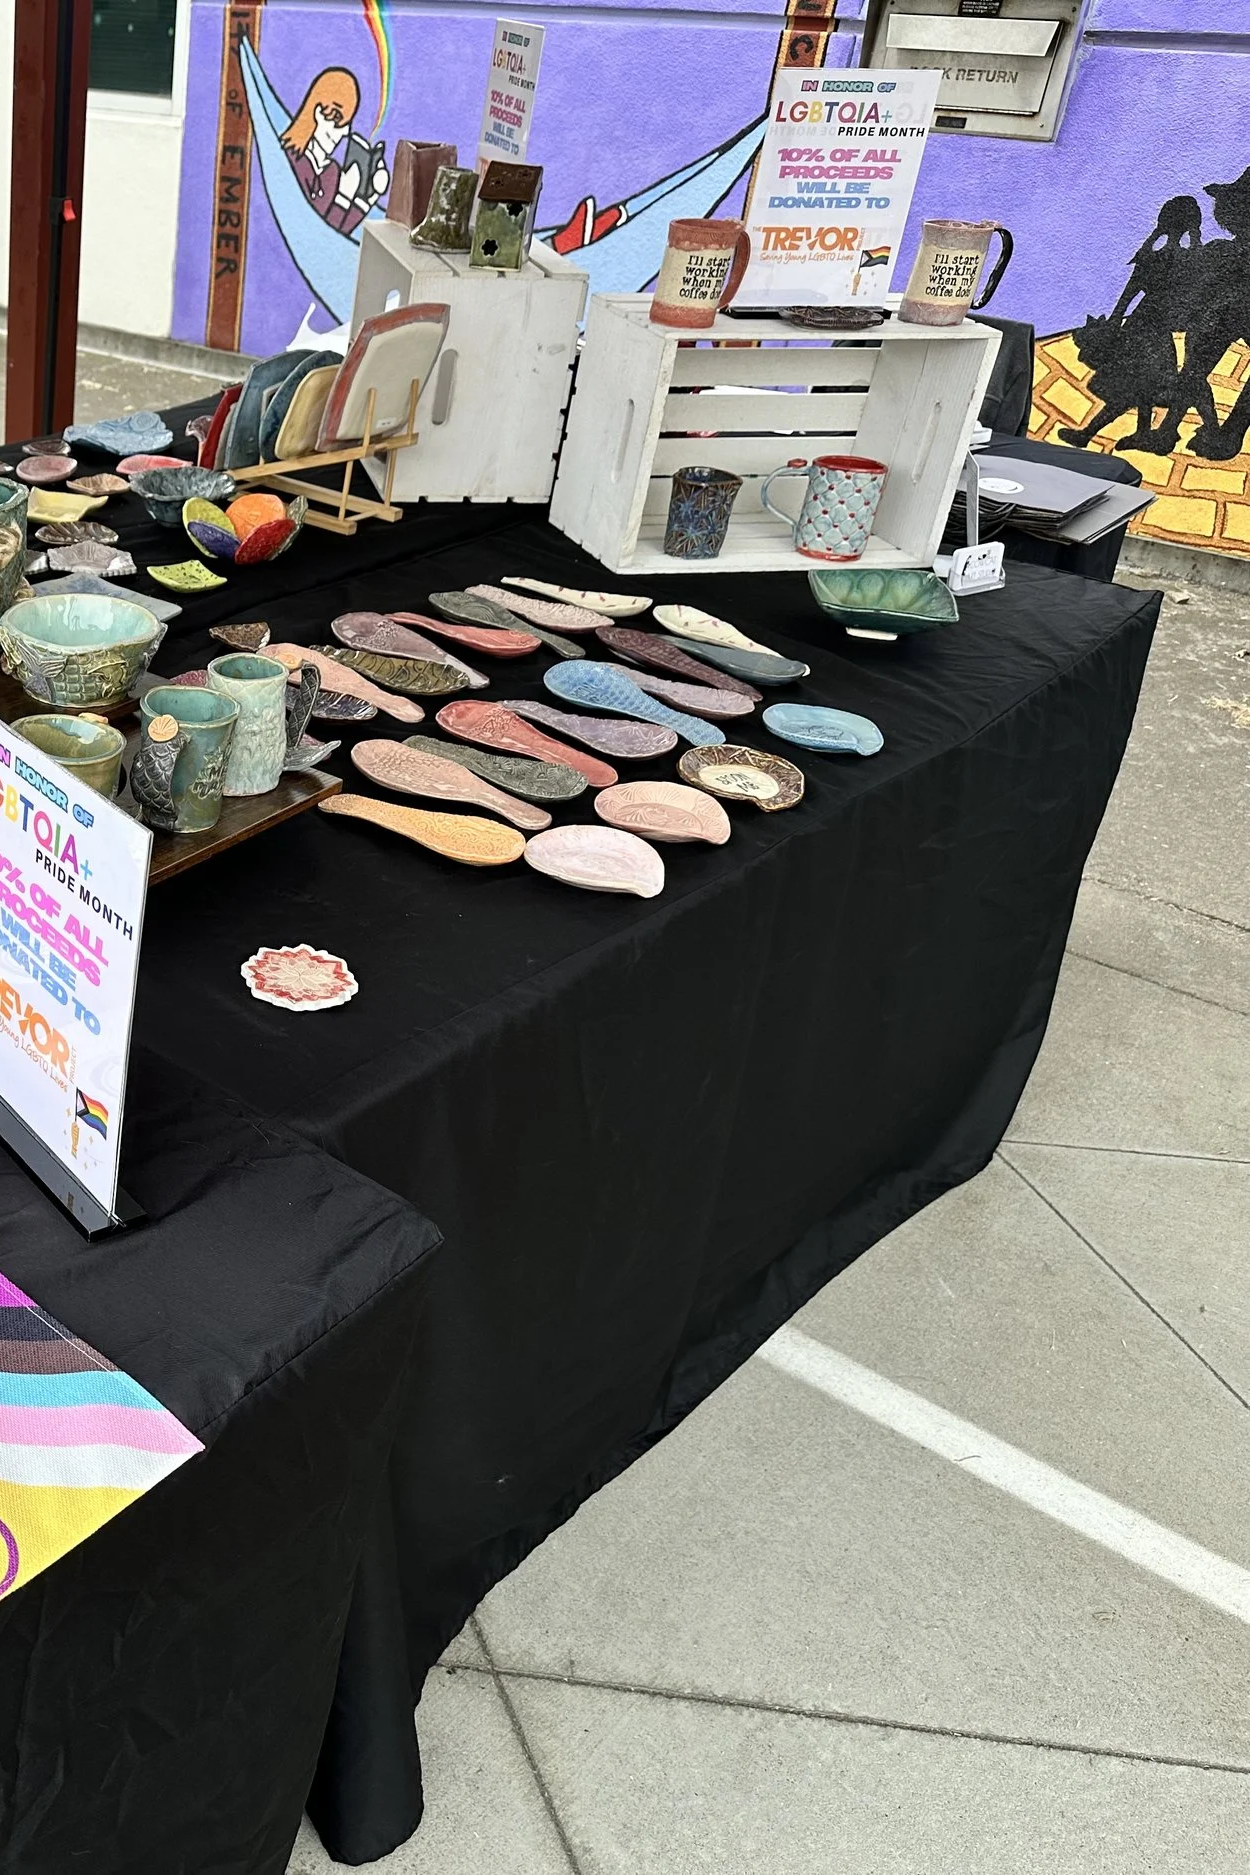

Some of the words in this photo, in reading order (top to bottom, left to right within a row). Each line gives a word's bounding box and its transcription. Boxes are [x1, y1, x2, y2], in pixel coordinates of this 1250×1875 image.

[955, 68, 1019, 84] RETURN
[801, 80, 818, 92] IN
[822, 80, 874, 93] HONOR
[877, 82, 896, 93] OF
[504, 93, 513, 109] OF
[514, 96, 525, 113] ALL
[489, 105, 523, 128] PROCEEDS
[775, 101, 892, 124] LGBTQIA+
[838, 127, 875, 137] PRIDE
[878, 127, 925, 137] MONTH
[778, 148, 825, 162] 10%
[829, 149, 860, 162] OF
[862, 149, 901, 163] ALL
[779, 166, 893, 179] PROCEEDS
[796, 182, 840, 194] WILL
[844, 182, 871, 194] BE
[215, 144, 246, 279] EMBER
[768, 197, 861, 209] DONATED
[865, 197, 890, 209] TO
[762, 226, 859, 251] TREVOR
[934, 254, 949, 264] I'll
[952, 255, 979, 265] start
[931, 265, 978, 277] working
[928, 275, 957, 286] when
[961, 277, 976, 288] my
[925, 286, 953, 297] coffee
[15, 756, 68, 813] HONOR
[72, 803, 94, 829] OF
[35, 849, 76, 893] PRIDE
[79, 884, 134, 941] MONTH
[30, 883, 61, 918] OF
[63, 913, 109, 968] ALL
[0, 907, 45, 964] WILL
[49, 949, 77, 992] BE
[72, 996, 101, 1036] TO
[21, 1038, 49, 1076] LGBTQ
[50, 1067, 68, 1093] Lives
